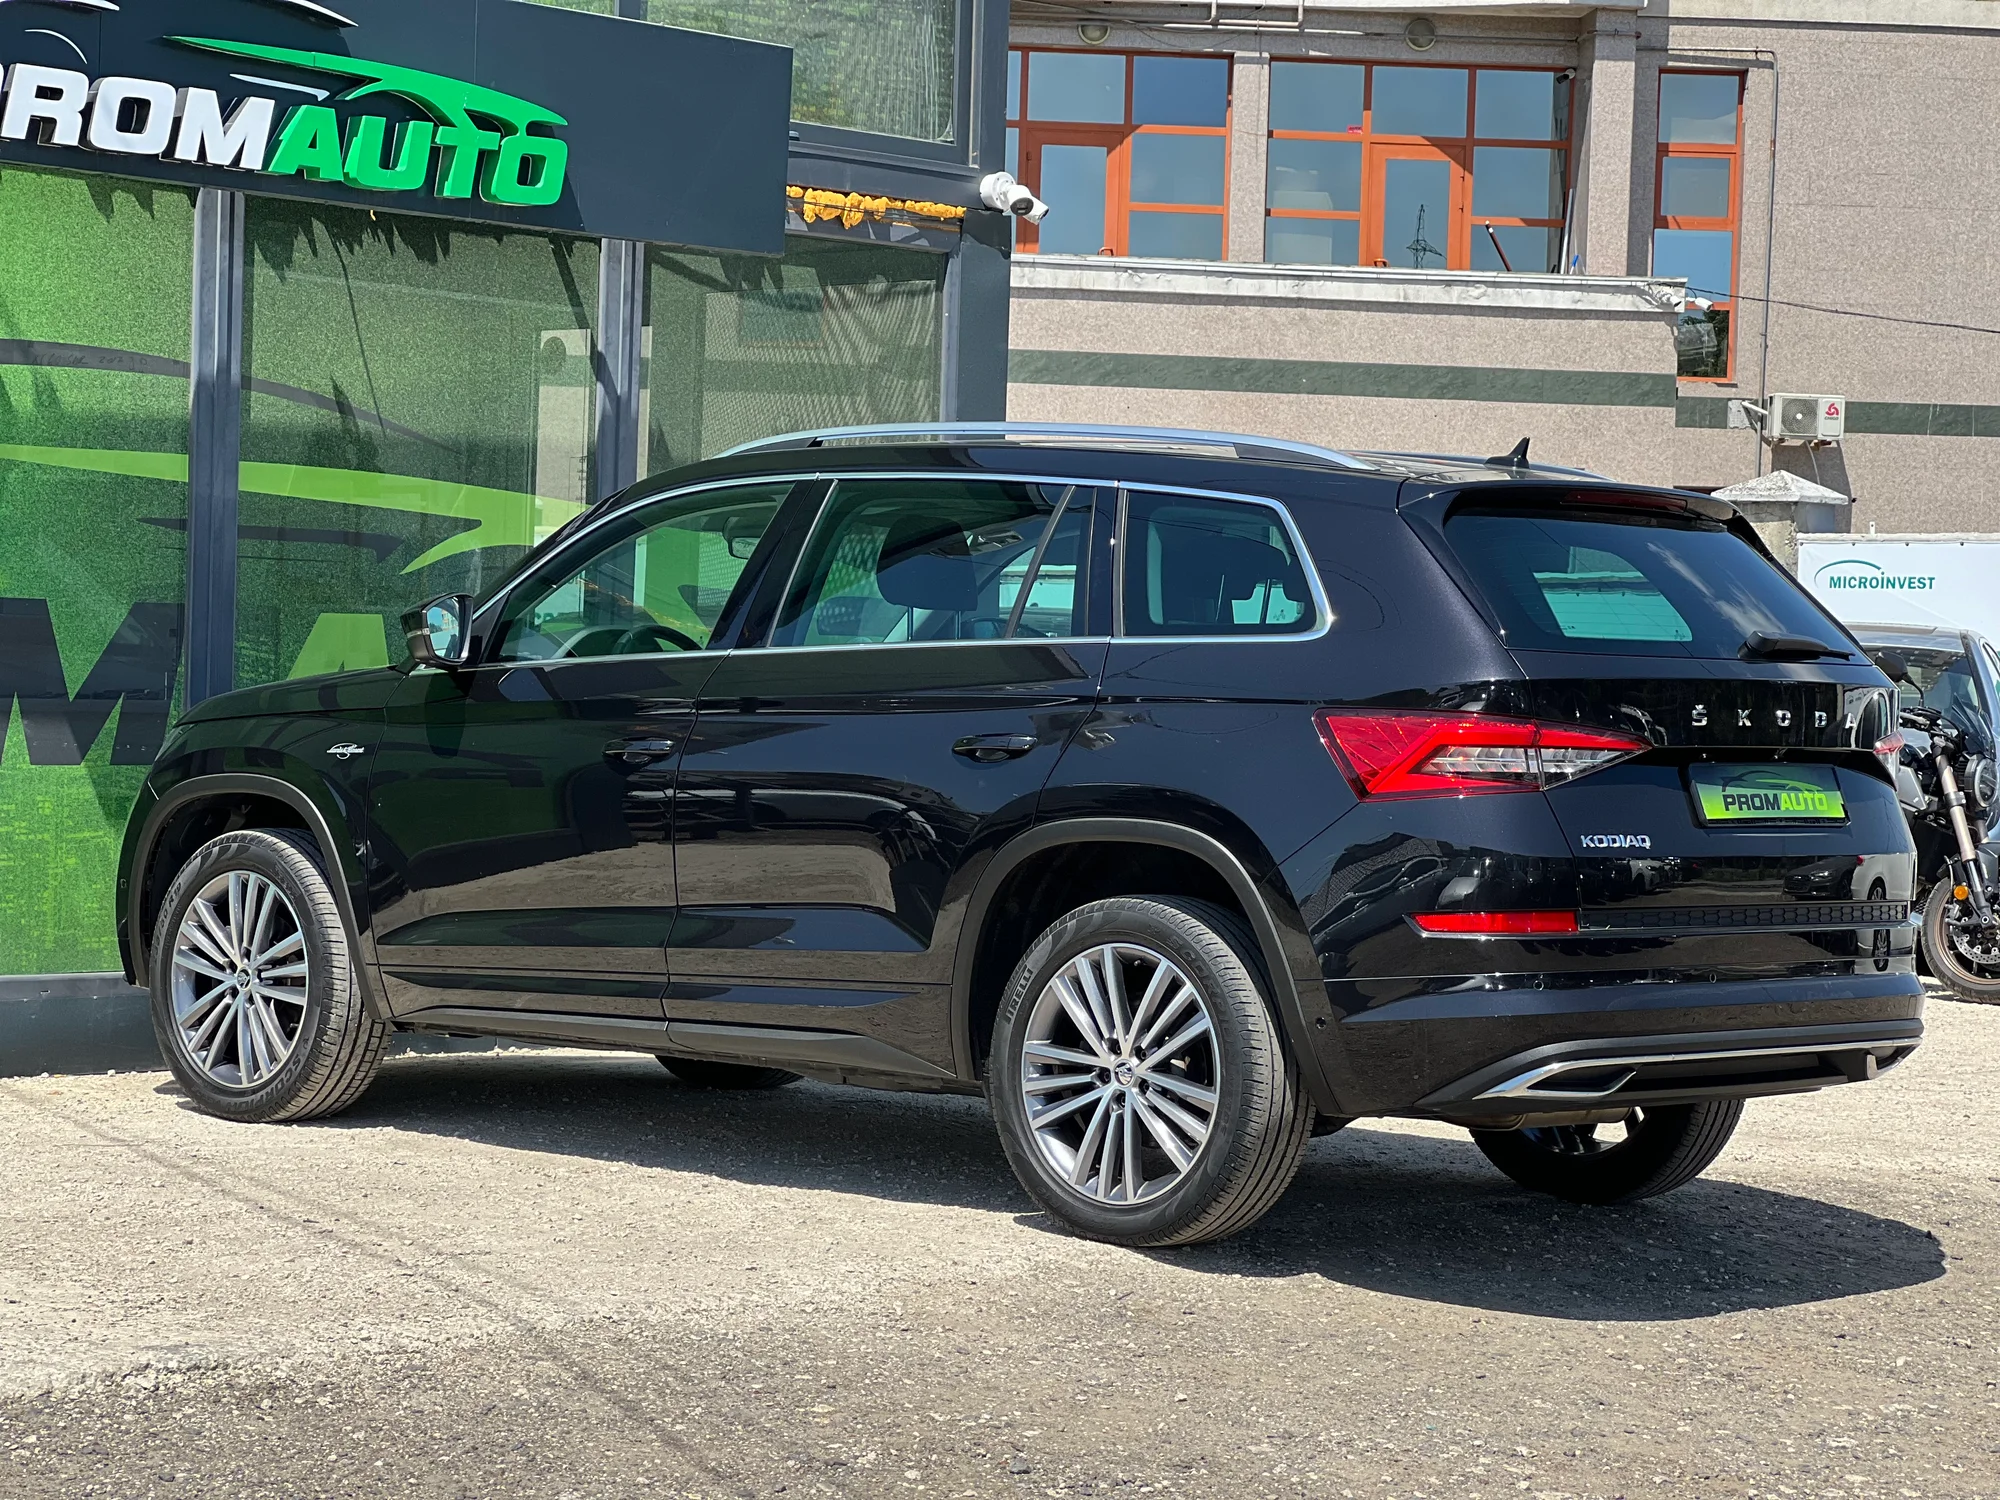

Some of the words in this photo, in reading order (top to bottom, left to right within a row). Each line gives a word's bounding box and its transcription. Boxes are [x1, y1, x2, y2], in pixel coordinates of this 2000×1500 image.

[0, 62, 568, 206] ROMAUTO
[1722, 792, 1828, 812] PROMAUTO
[1580, 834, 1651, 849] KODIAQ
